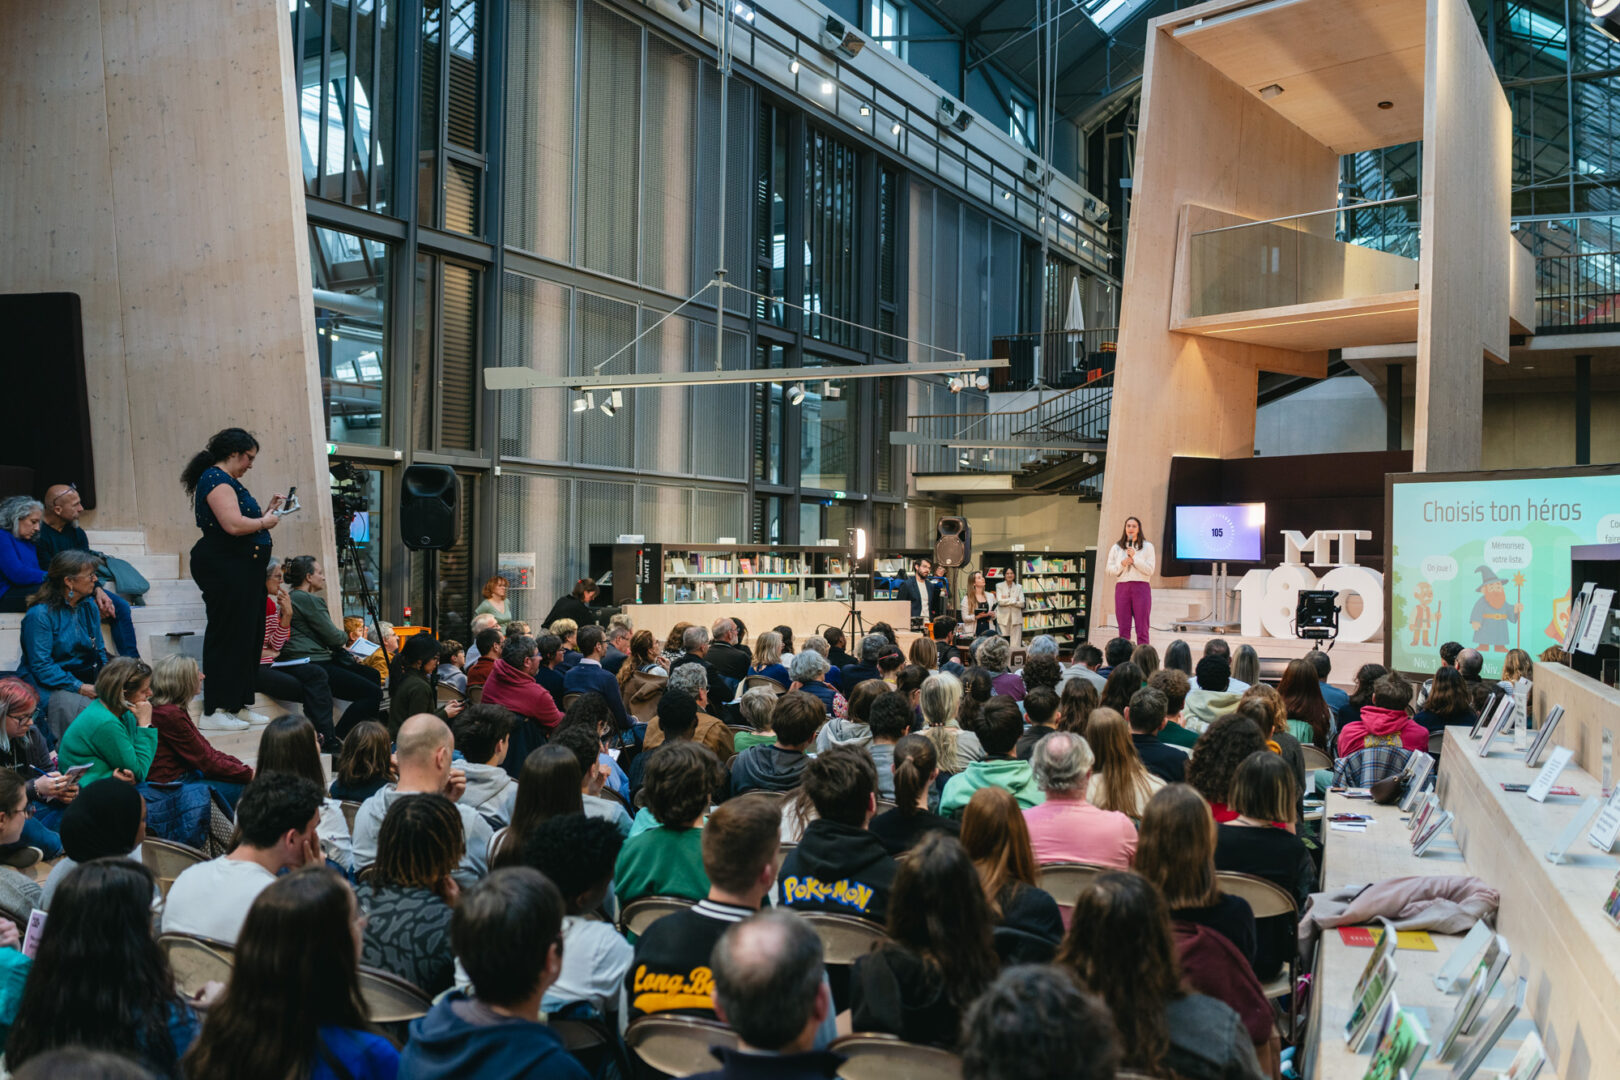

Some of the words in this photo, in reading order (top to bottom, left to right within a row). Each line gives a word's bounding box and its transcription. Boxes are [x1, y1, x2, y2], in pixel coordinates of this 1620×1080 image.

[1423, 500, 1485, 523] Choisis
[1489, 501, 1521, 522] ton
[1527, 497, 1582, 521] héros
[1211, 527, 1223, 537] 105
[1279, 529, 1373, 567] MT
[1491, 541, 1525, 550] Mémorisez
[1492, 556, 1507, 564] votre
[1233, 566, 1385, 642] 180
[633, 963, 685, 999] Long
